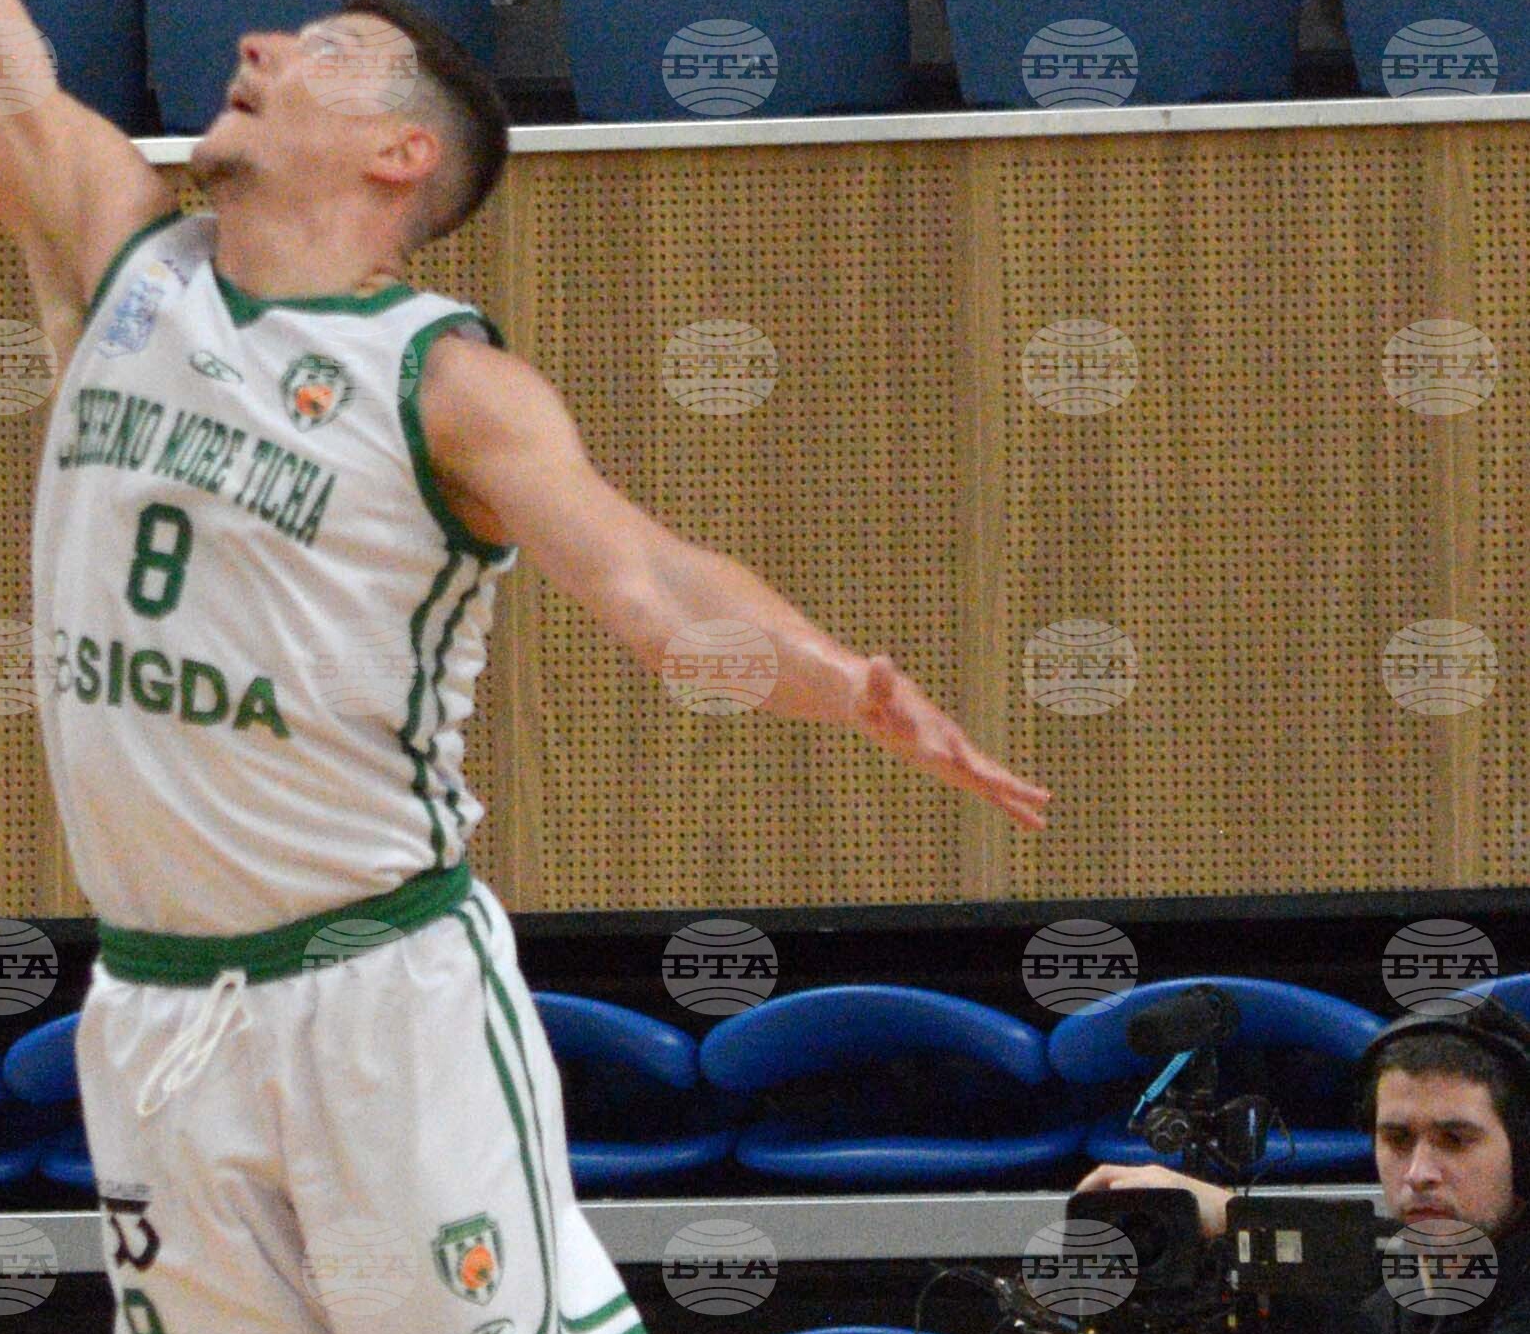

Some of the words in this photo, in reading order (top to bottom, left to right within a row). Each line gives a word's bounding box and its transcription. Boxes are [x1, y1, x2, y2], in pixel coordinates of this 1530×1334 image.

[153, 410, 247, 494] MORE
[233, 438, 337, 547] TICHA
[125, 501, 194, 620] 8
[75, 634, 291, 740] SIGDA
